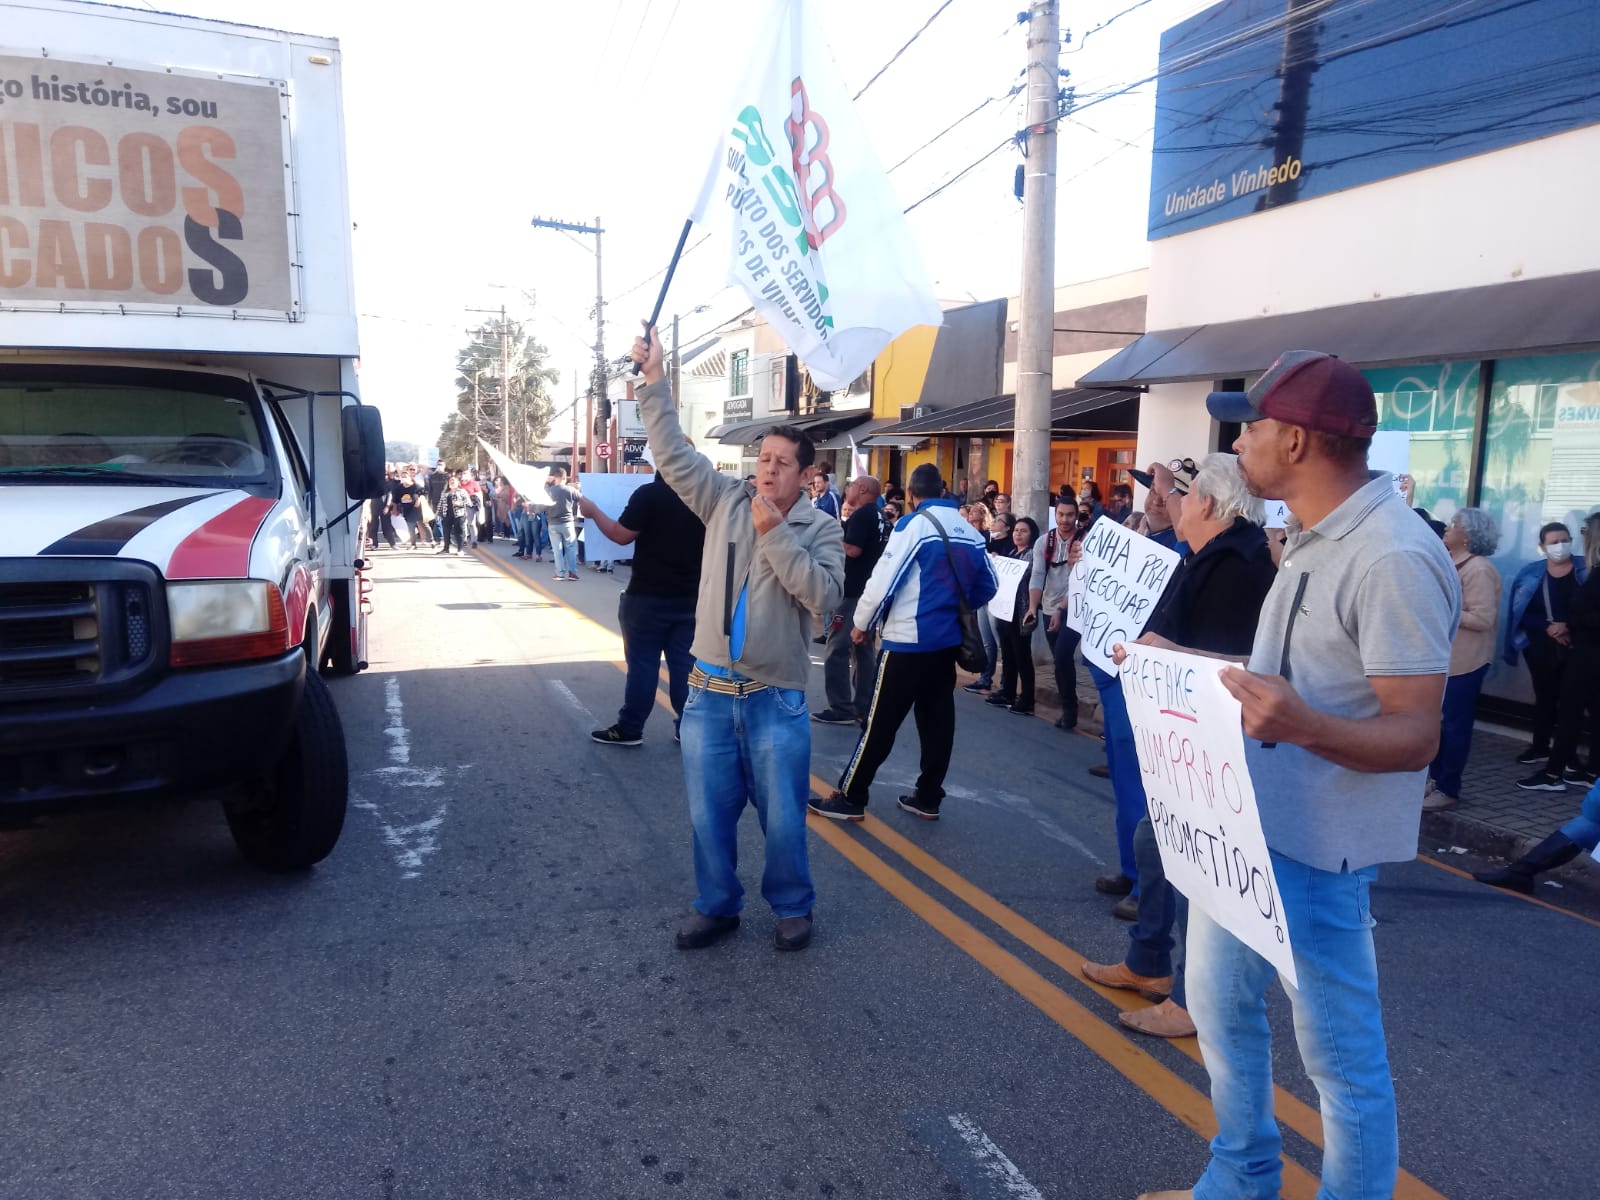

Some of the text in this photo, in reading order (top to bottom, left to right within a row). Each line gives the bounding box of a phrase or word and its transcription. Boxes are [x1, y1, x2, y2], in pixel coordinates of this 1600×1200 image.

[0, 74, 218, 119] o história, sou
[1164, 155, 1302, 217] Unidade Vinhedo
[758, 220, 790, 261] DOS
[744, 254, 771, 282] DE
[1135, 553, 1169, 593] PRA
[1122, 653, 1197, 714] PREFAKE
